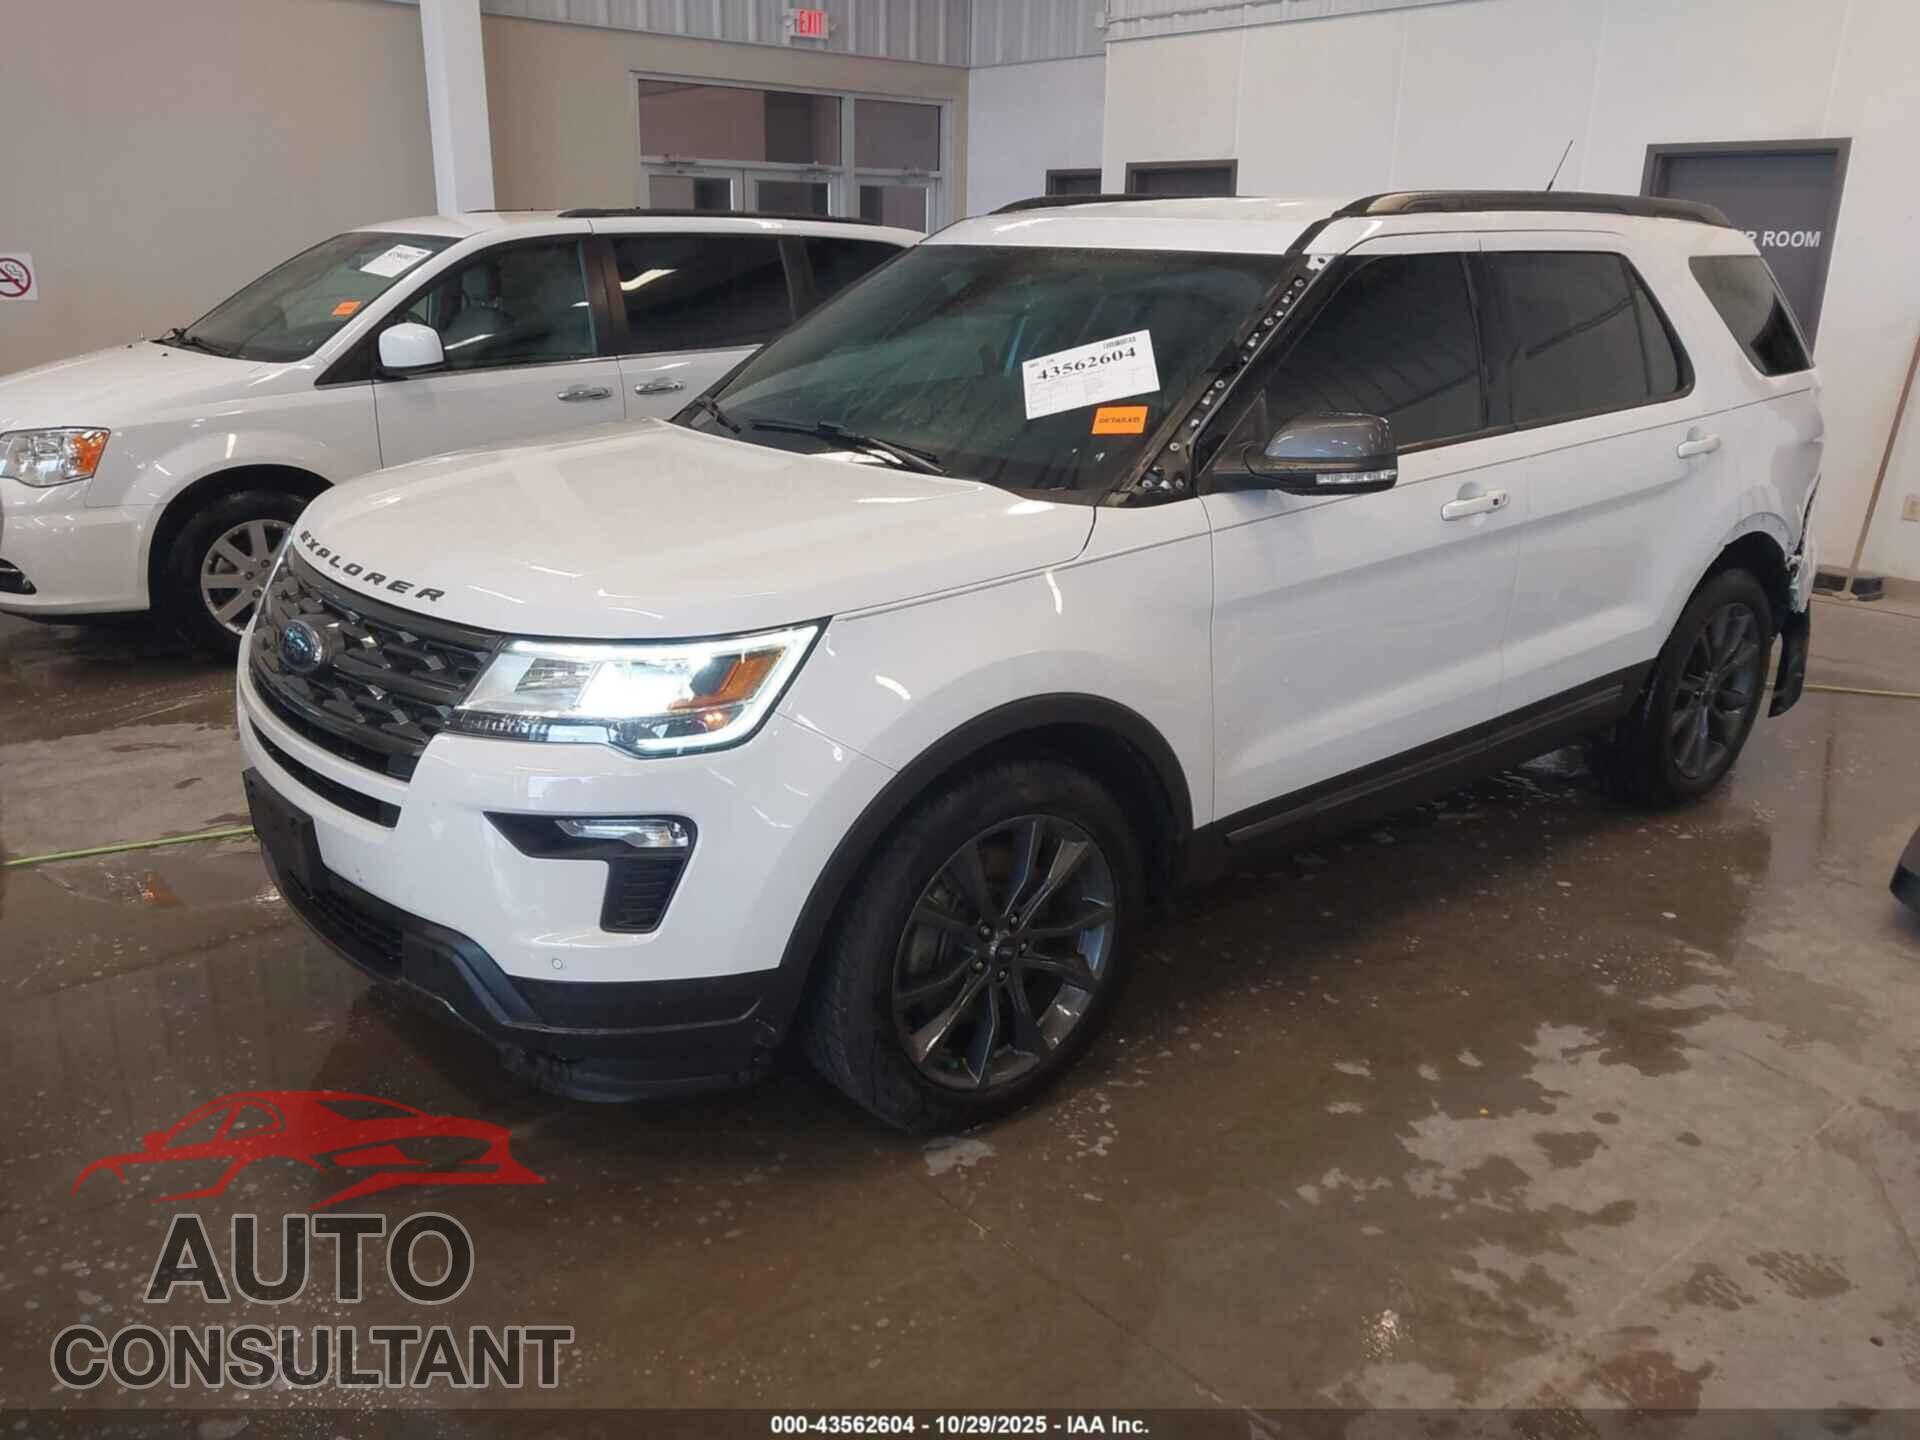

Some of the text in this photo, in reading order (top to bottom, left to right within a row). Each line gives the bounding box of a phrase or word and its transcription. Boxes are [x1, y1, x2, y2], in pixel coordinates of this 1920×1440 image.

[800, 11, 823, 33] EXIT
[1762, 230, 1822, 248] ROOM
[1037, 347, 1136, 379] 43562604
[299, 530, 446, 602] EXPLORER
